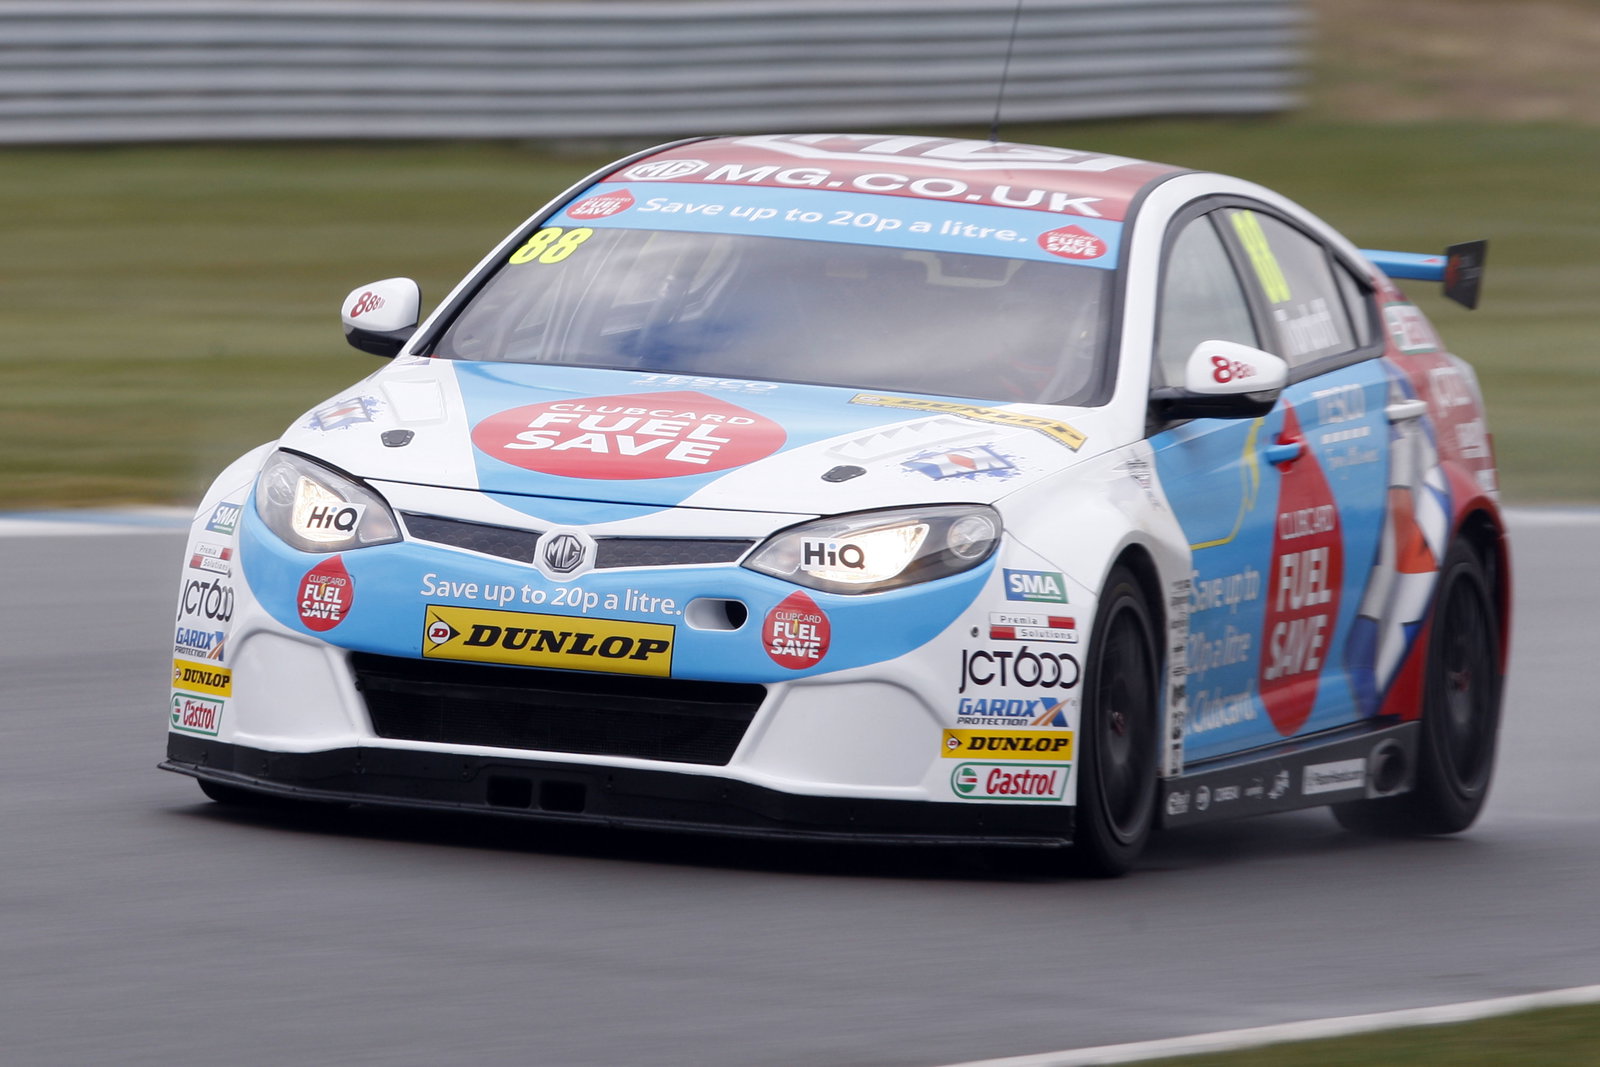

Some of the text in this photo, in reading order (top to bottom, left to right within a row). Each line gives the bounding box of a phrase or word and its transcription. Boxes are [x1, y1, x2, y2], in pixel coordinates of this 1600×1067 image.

[632, 160, 702, 180] MG
[704, 164, 1103, 217] MG.CO.UK
[571, 206, 620, 215] SAVE
[581, 200, 621, 210] FUEL
[636, 198, 1028, 243] Save up to 20p a litre.
[508, 227, 593, 264] 88
[1046, 243, 1098, 256] SAVE
[1047, 236, 1098, 249] FUEL
[631, 374, 779, 392] TESCO
[549, 403, 756, 425] CLUBCARD
[527, 412, 731, 443] FUEL
[503, 430, 721, 464] SAVE
[211, 506, 241, 527] SMA
[306, 506, 358, 532] HiQ
[546, 534, 583, 570] MG
[804, 541, 865, 570] HiQ
[308, 574, 346, 587] CLUBCARD
[1010, 573, 1061, 595] SMA
[1276, 547, 1332, 612] FUEL
[177, 578, 234, 622] JCT600
[304, 584, 343, 604] FUEL
[420, 573, 683, 616] Save up to 20p a litre.
[302, 601, 341, 620] SAVE
[775, 611, 822, 624] CLUBCARD
[1000, 616, 1038, 625] Premia
[773, 621, 821, 641] FUEL
[1021, 629, 1073, 640] Solutions
[463, 624, 670, 661] DUNLOP
[770, 638, 820, 659] SAVE
[1264, 615, 1328, 680] SAVE
[183, 668, 230, 688] DUNLOP
[958, 646, 1081, 694] JCT600
[183, 700, 217, 730] Castrol
[958, 698, 1041, 718] GARDX
[957, 717, 1028, 727] PROTECTION
[967, 736, 1069, 752] DUNLOP
[986, 768, 1057, 795] Castrol
